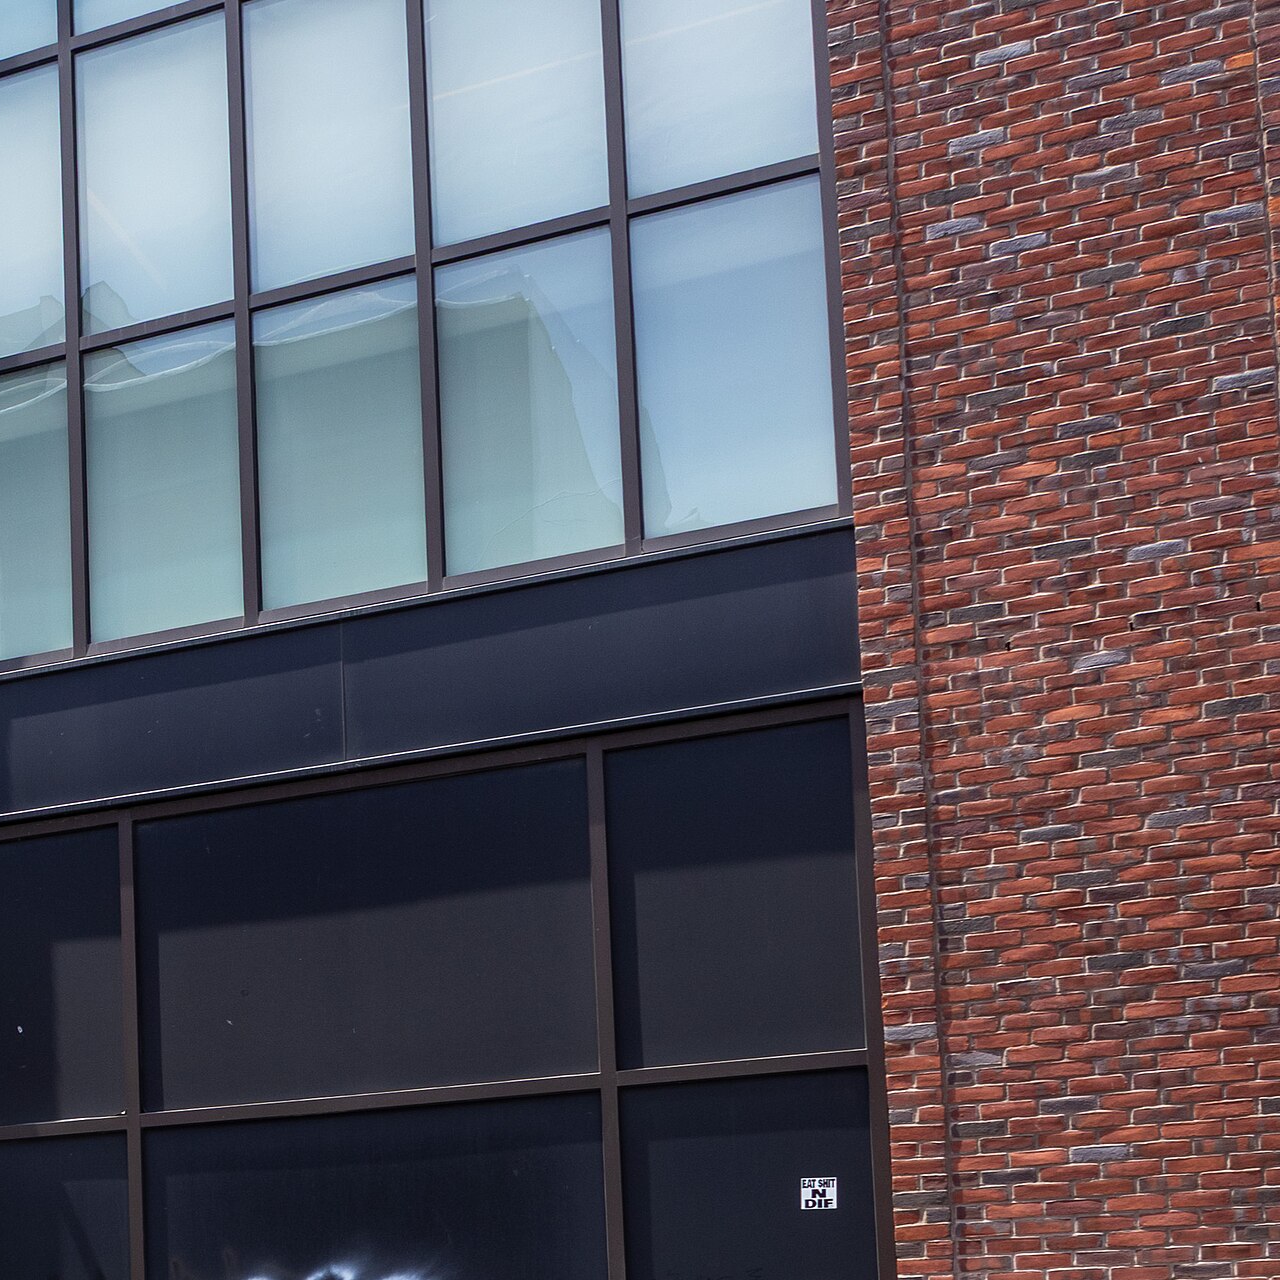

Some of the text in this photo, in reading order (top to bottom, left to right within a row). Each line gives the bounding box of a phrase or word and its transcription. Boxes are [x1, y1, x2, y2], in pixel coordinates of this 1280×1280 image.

[802, 1179, 835, 1188] EAT SHIT
[811, 1189, 826, 1198] N
[805, 1199, 833, 1208] DIF
